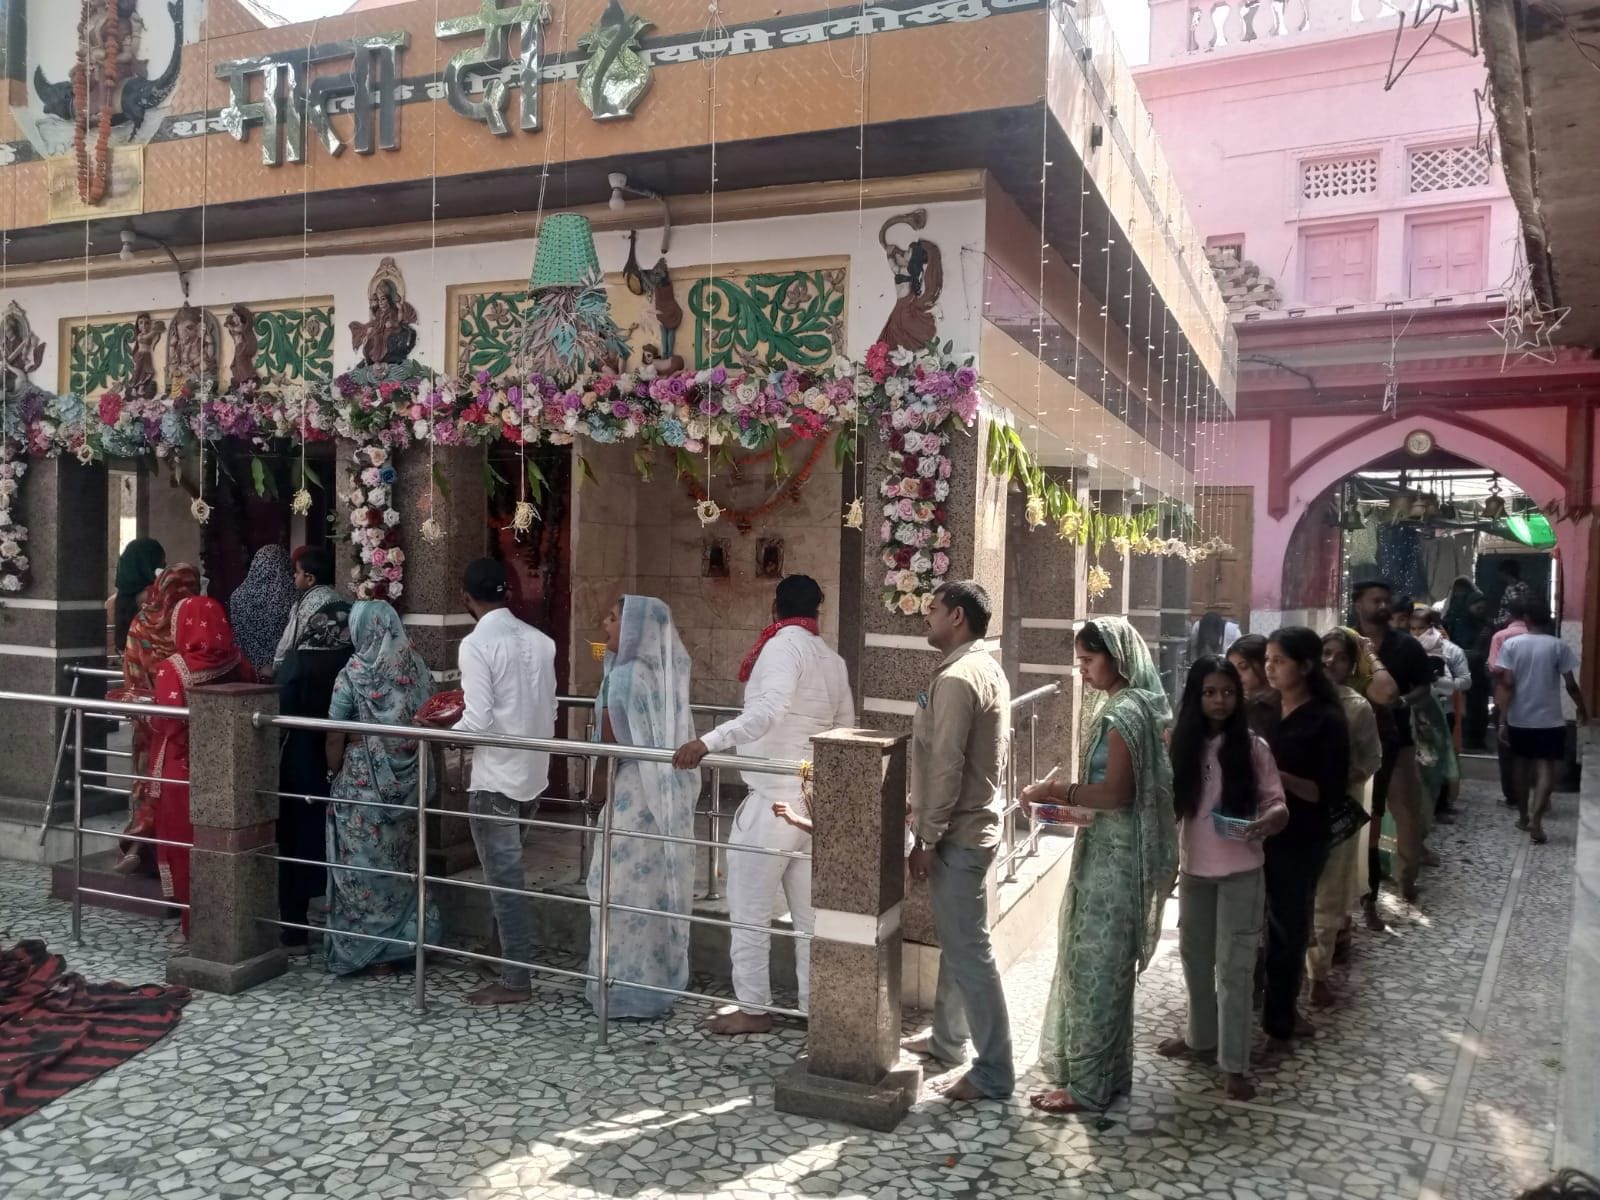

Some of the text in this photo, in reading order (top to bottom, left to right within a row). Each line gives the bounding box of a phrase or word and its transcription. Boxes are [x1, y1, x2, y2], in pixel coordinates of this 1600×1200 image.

[214, 0, 552, 167] माता दी
[538, 28, 776, 81] नायणी
[780, 0, 1041, 43] नमोस्तु
